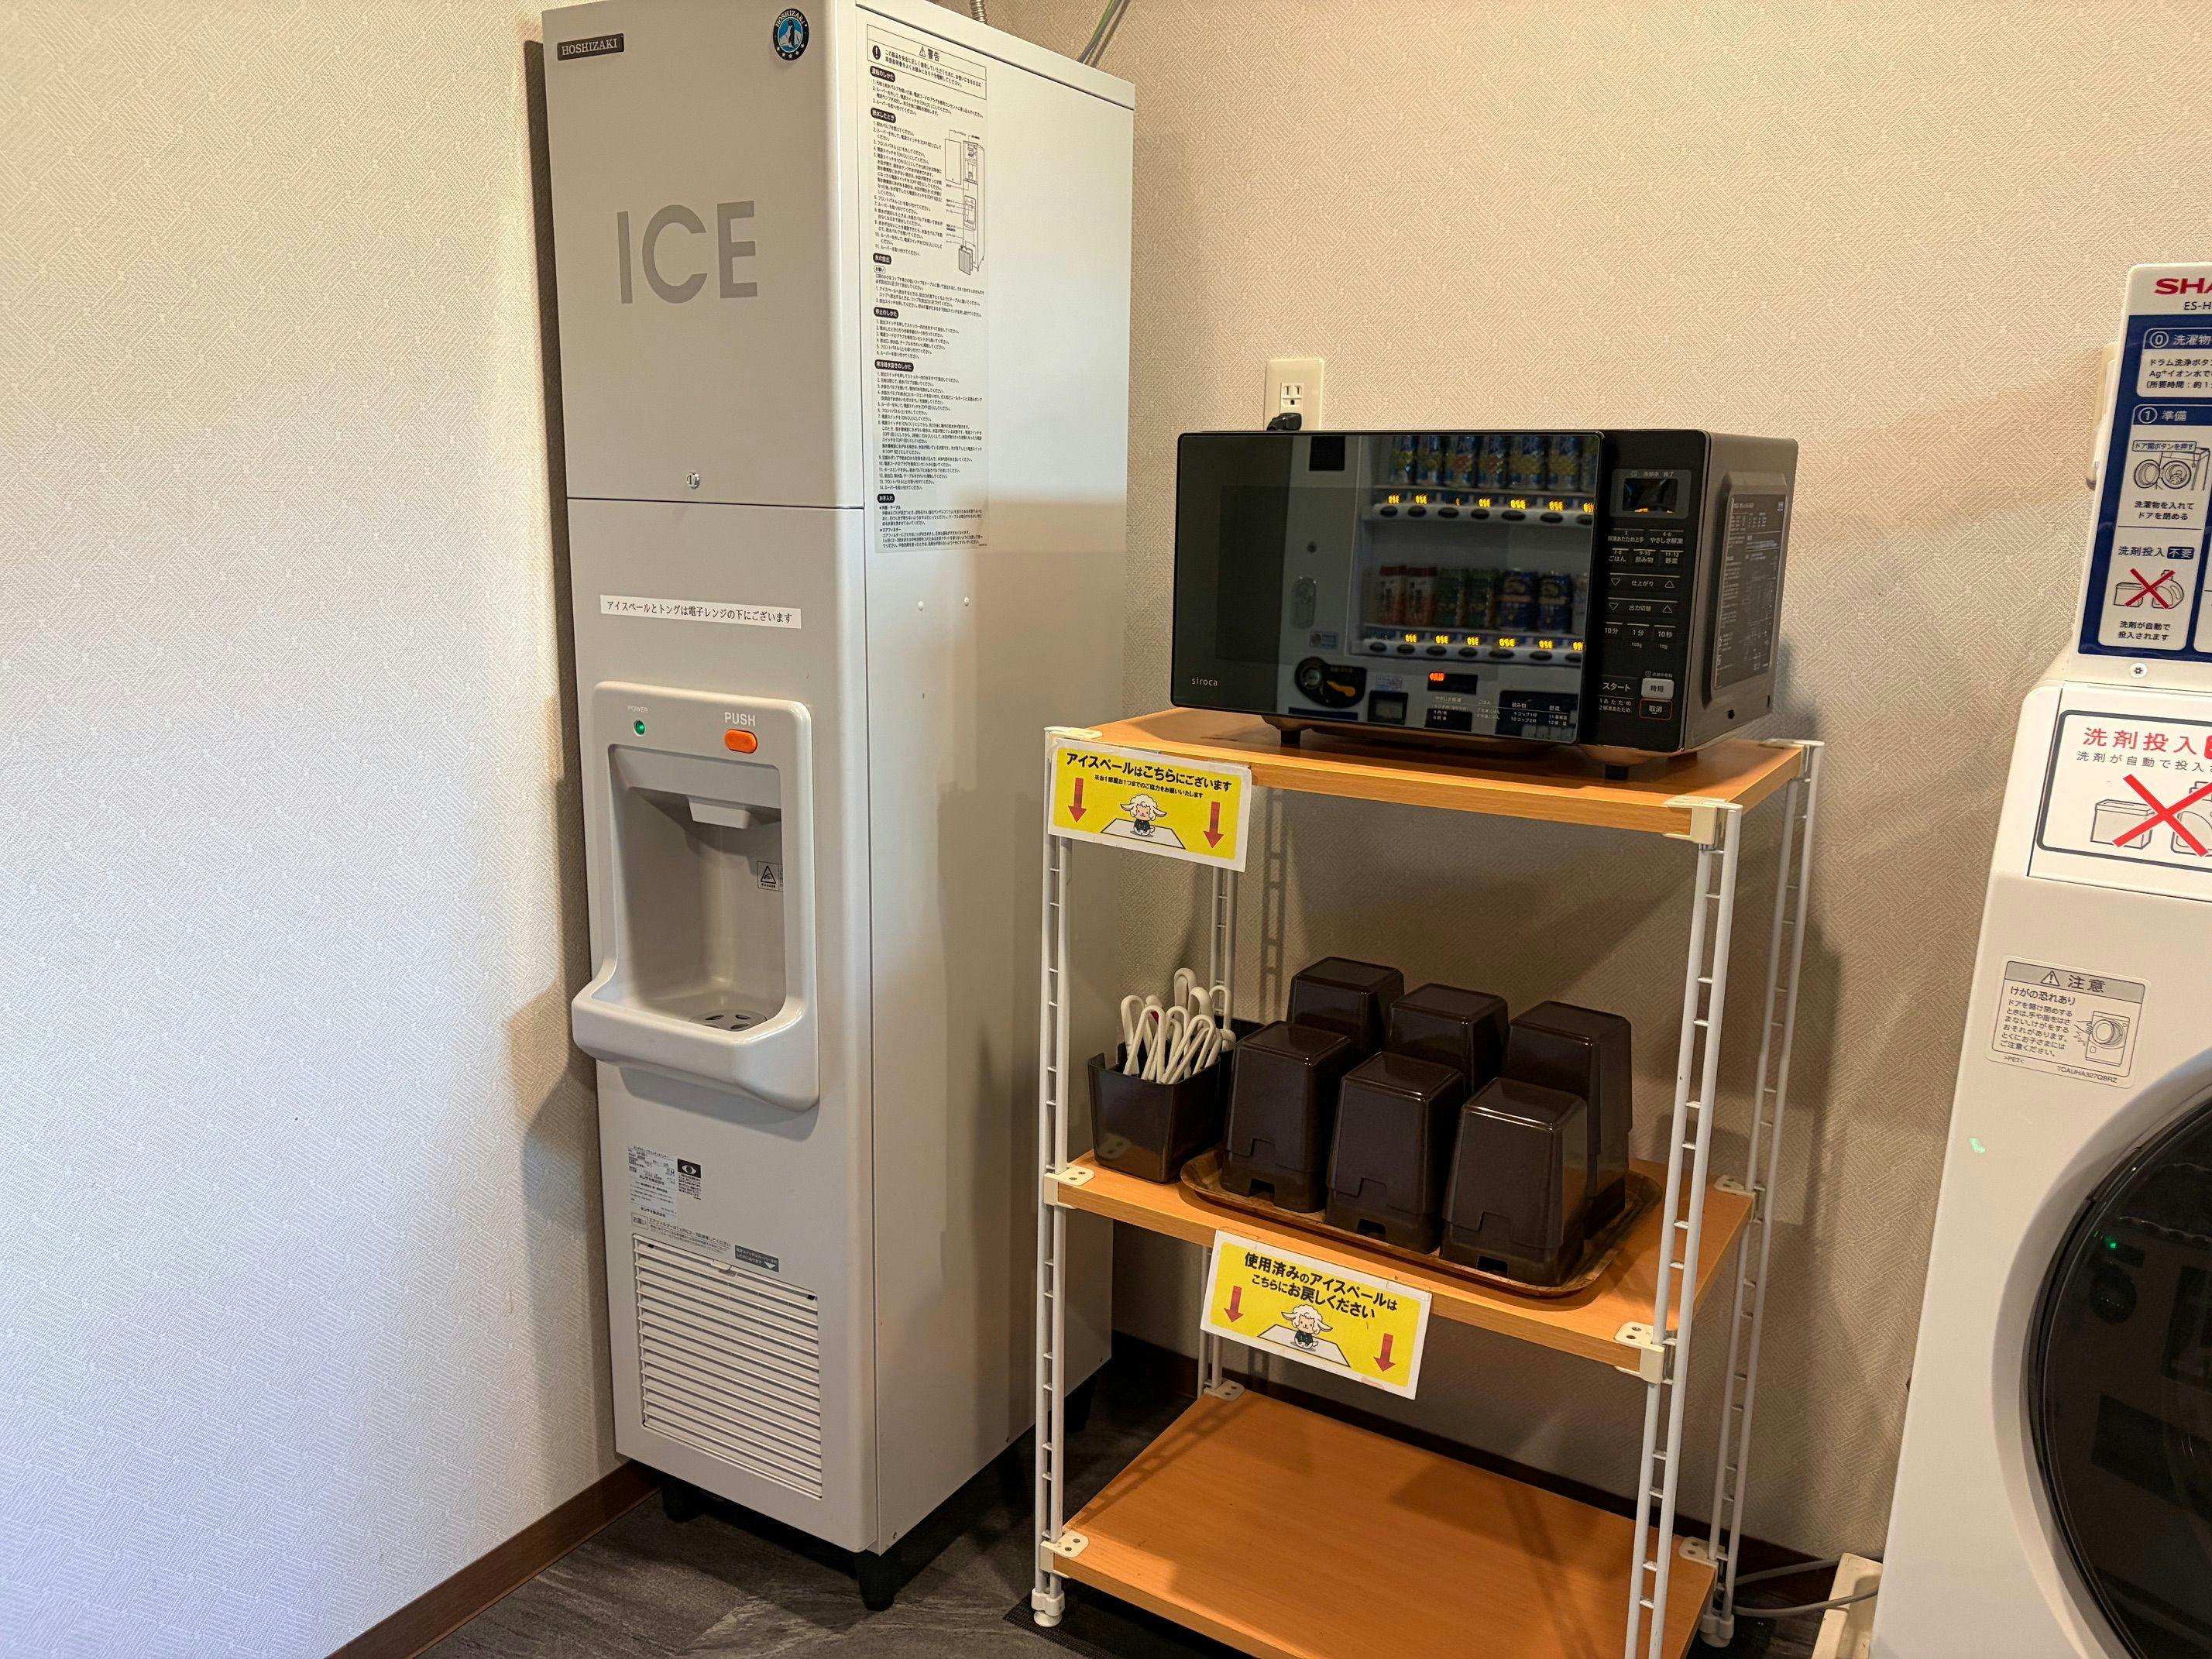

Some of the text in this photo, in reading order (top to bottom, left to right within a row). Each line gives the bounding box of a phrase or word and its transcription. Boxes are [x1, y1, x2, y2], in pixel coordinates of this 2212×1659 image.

[775, 9, 805, 27] HOSHIZAKI
[562, 39, 618, 57] HOSHIZAKI
[927, 48, 939, 63] 警告
[617, 201, 758, 306] ICE
[2173, 334, 2212, 345] 洗濯物
[2149, 370, 2212, 379] Ag+イオン水で
[2162, 410, 2187, 421] 準備
[2135, 442, 2194, 452] ドア開ボタンを押す
[2135, 501, 2194, 510] 洗濯物を入れて
[2138, 512, 2189, 521] ドアを閉める
[2118, 546, 2193, 558] 洗剤投入 不要
[607, 600, 792, 624] アイスペールとトングは電子レンジの下にございます
[2120, 620, 2171, 631] 洗剤が自動で
[2118, 631, 2169, 642] 投入されます
[1192, 676, 1218, 687] siroca
[1602, 682, 1631, 692] スタート
[724, 712, 756, 726] PUSH
[2083, 726, 2197, 756] 洗剤投入
[1066, 753, 1232, 792] アイスペールはこちらにございます
[2067, 974, 2107, 993] 注意
[2011, 986, 2076, 1006] けがの恐れあり
[2008, 999, 2073, 1017] ドアを開け閉めする
[2002, 1032, 2065, 1050] とくにお子さまには
[2003, 1024, 2067, 1042] おそれがあります。
[2001, 1040, 2056, 1056] ご注意ください。
[1245, 1252, 1397, 1311] 使用済みのアイスペールは
[1252, 1273, 1376, 1319] こちらにお戻しください
